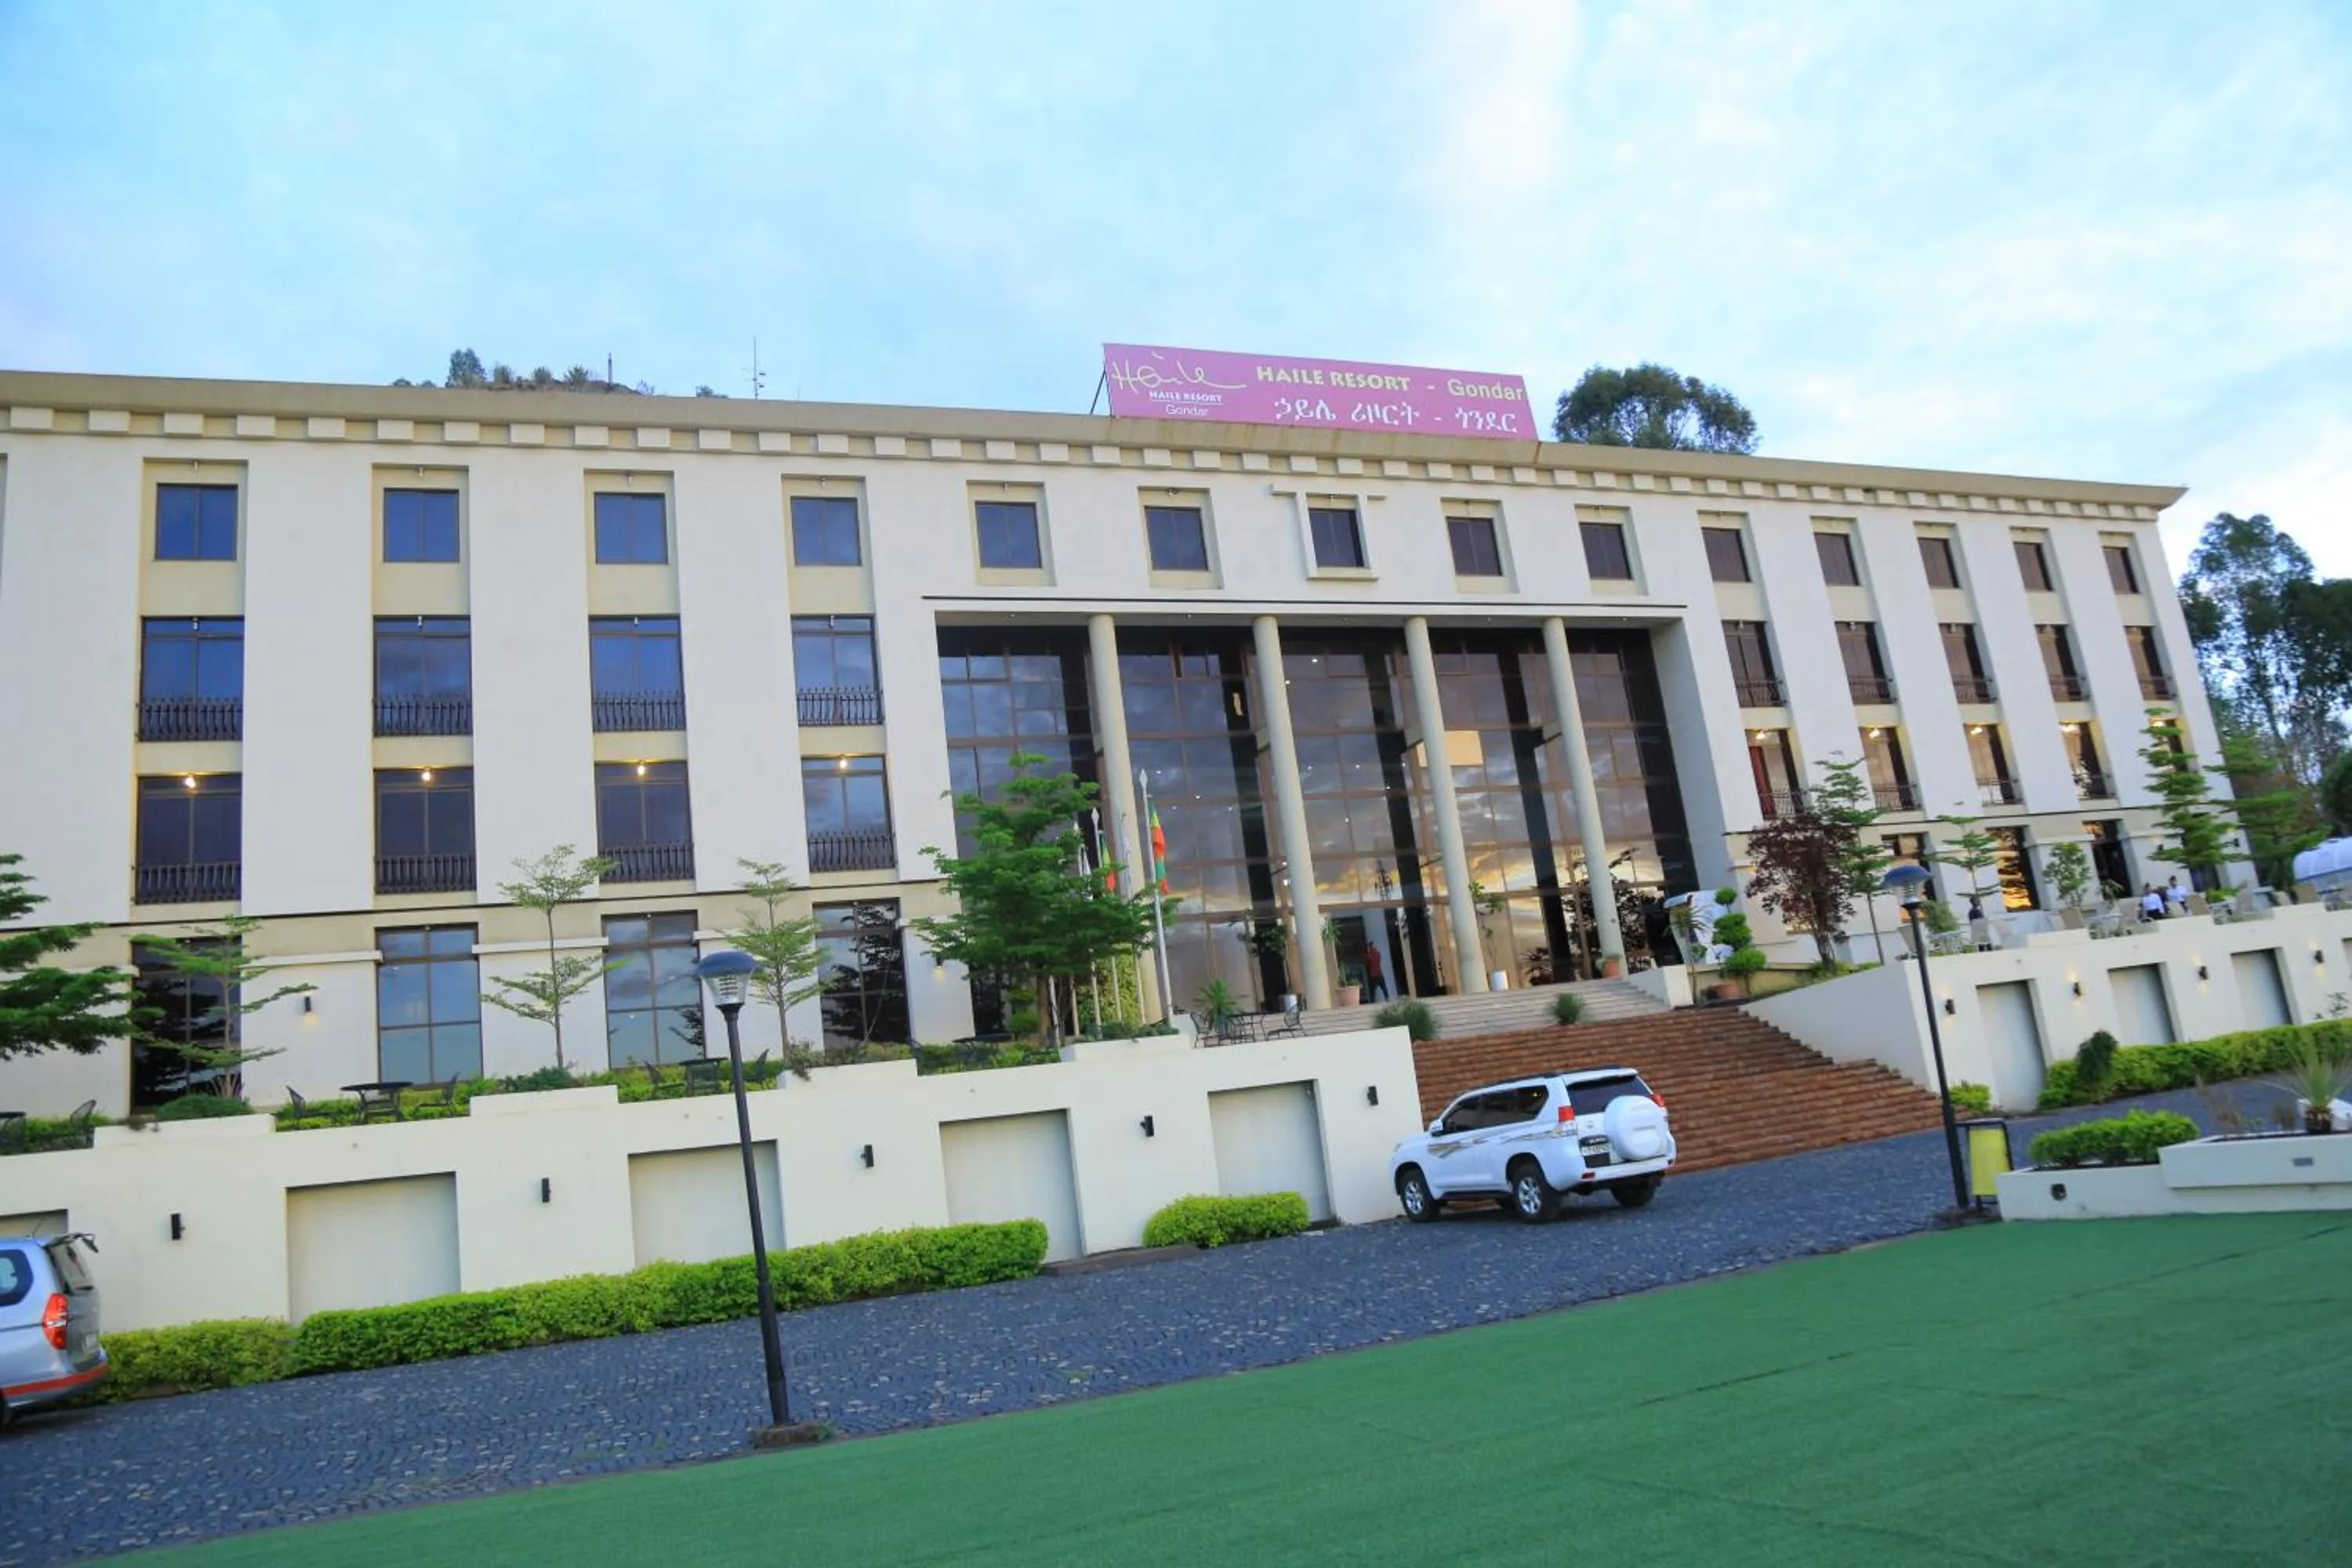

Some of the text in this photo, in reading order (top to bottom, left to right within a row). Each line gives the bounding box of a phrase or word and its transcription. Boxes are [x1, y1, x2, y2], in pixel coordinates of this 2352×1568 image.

[1256, 365, 1325, 385] HAILE
[1329, 371, 1410, 391] RESORT
[1446, 378, 1523, 401] Gondar
[1149, 390, 1223, 403] HAILE RESORT
[1166, 404, 1209, 416] Gondar
